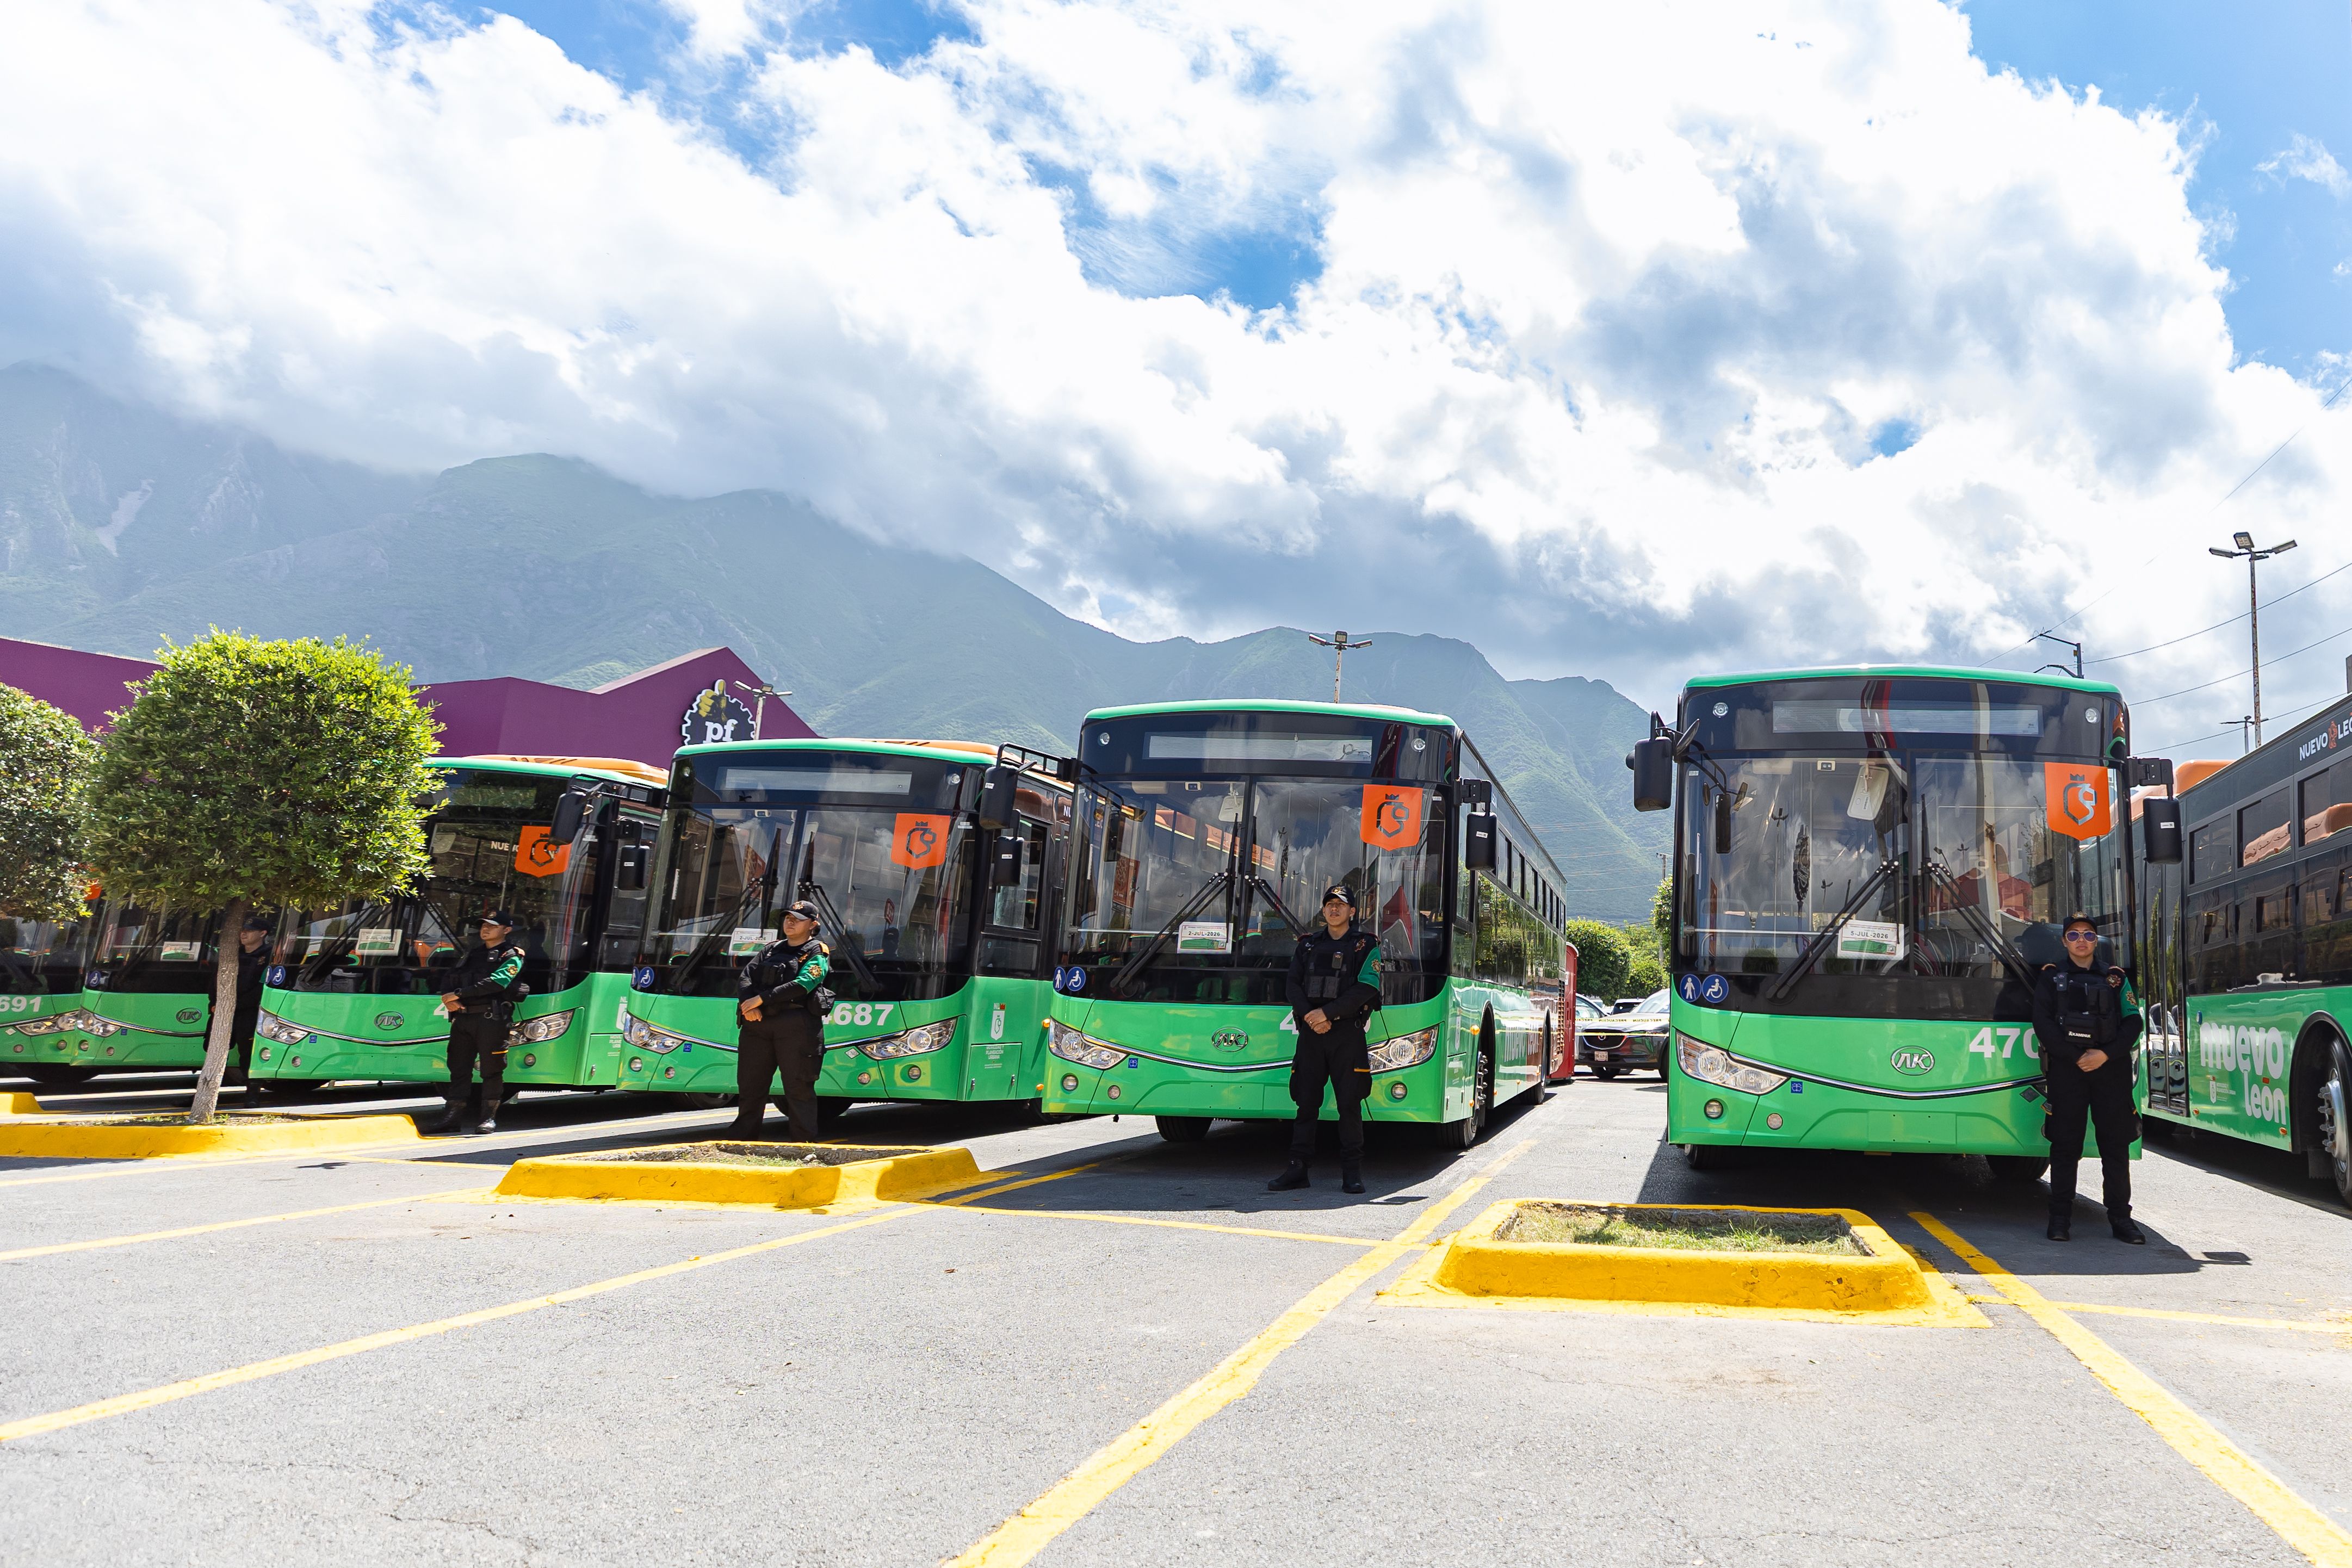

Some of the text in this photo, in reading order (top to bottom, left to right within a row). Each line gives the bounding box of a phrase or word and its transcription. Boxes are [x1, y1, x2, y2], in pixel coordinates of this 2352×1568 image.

[703, 719, 738, 743] pf
[2299, 732, 2328, 761] NUEVO
[1850, 931, 1889, 939] 5-JUL-2026
